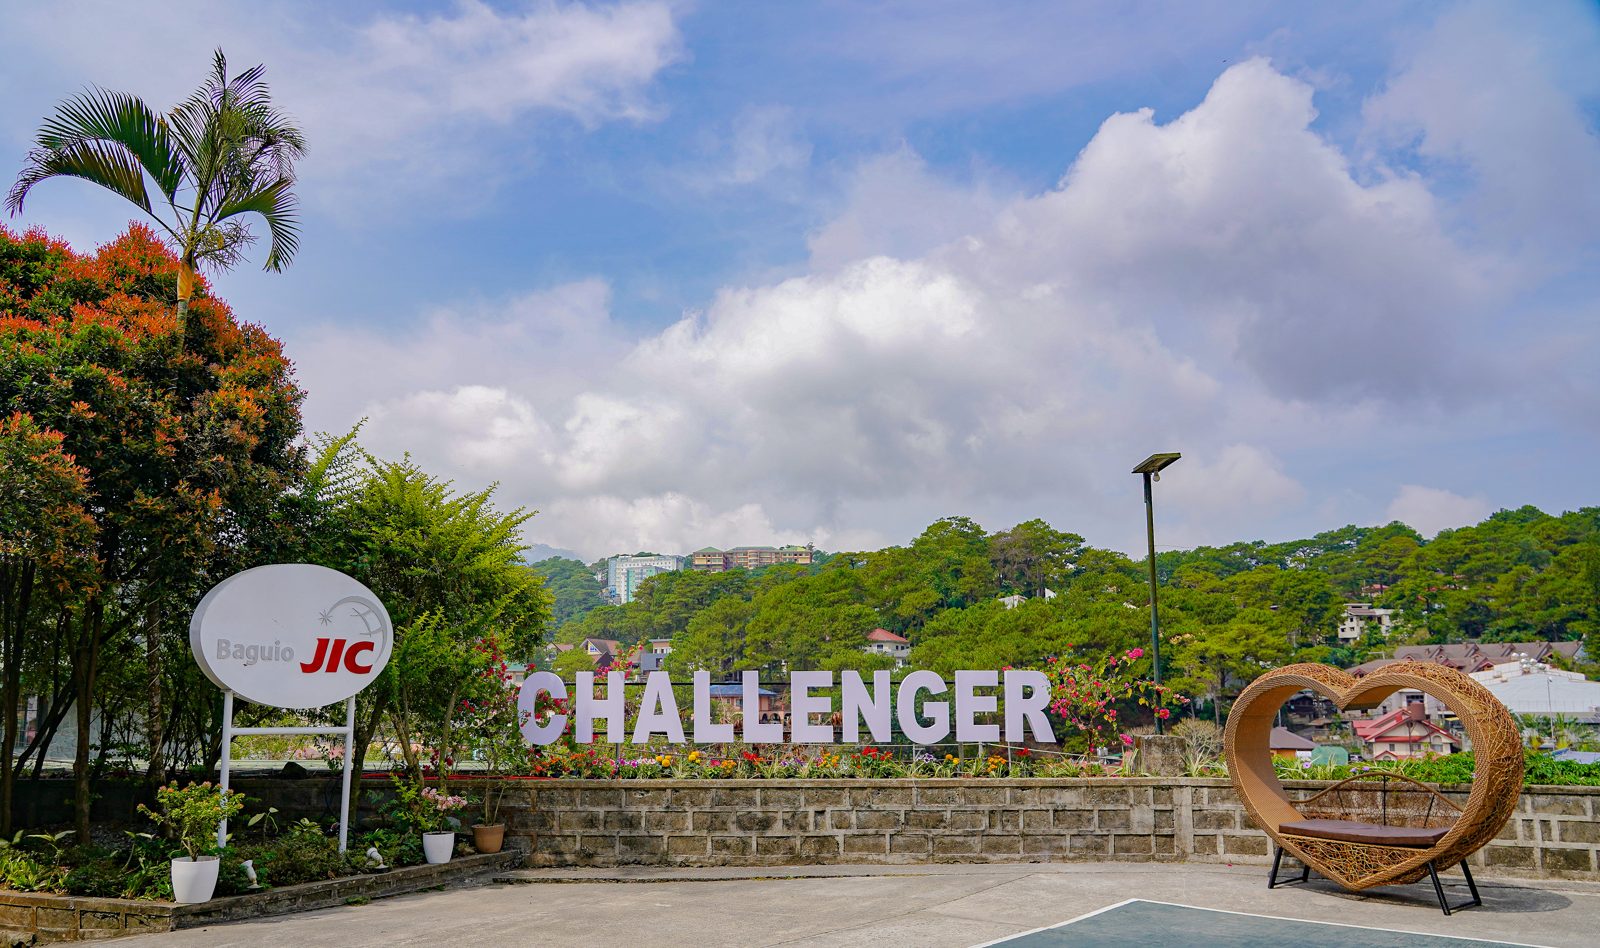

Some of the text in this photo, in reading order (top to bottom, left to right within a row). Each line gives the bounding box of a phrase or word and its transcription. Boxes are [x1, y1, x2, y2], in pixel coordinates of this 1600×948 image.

[216, 637, 375, 675] Baguio JIC
[517, 670, 1057, 745] CHALLENGER
